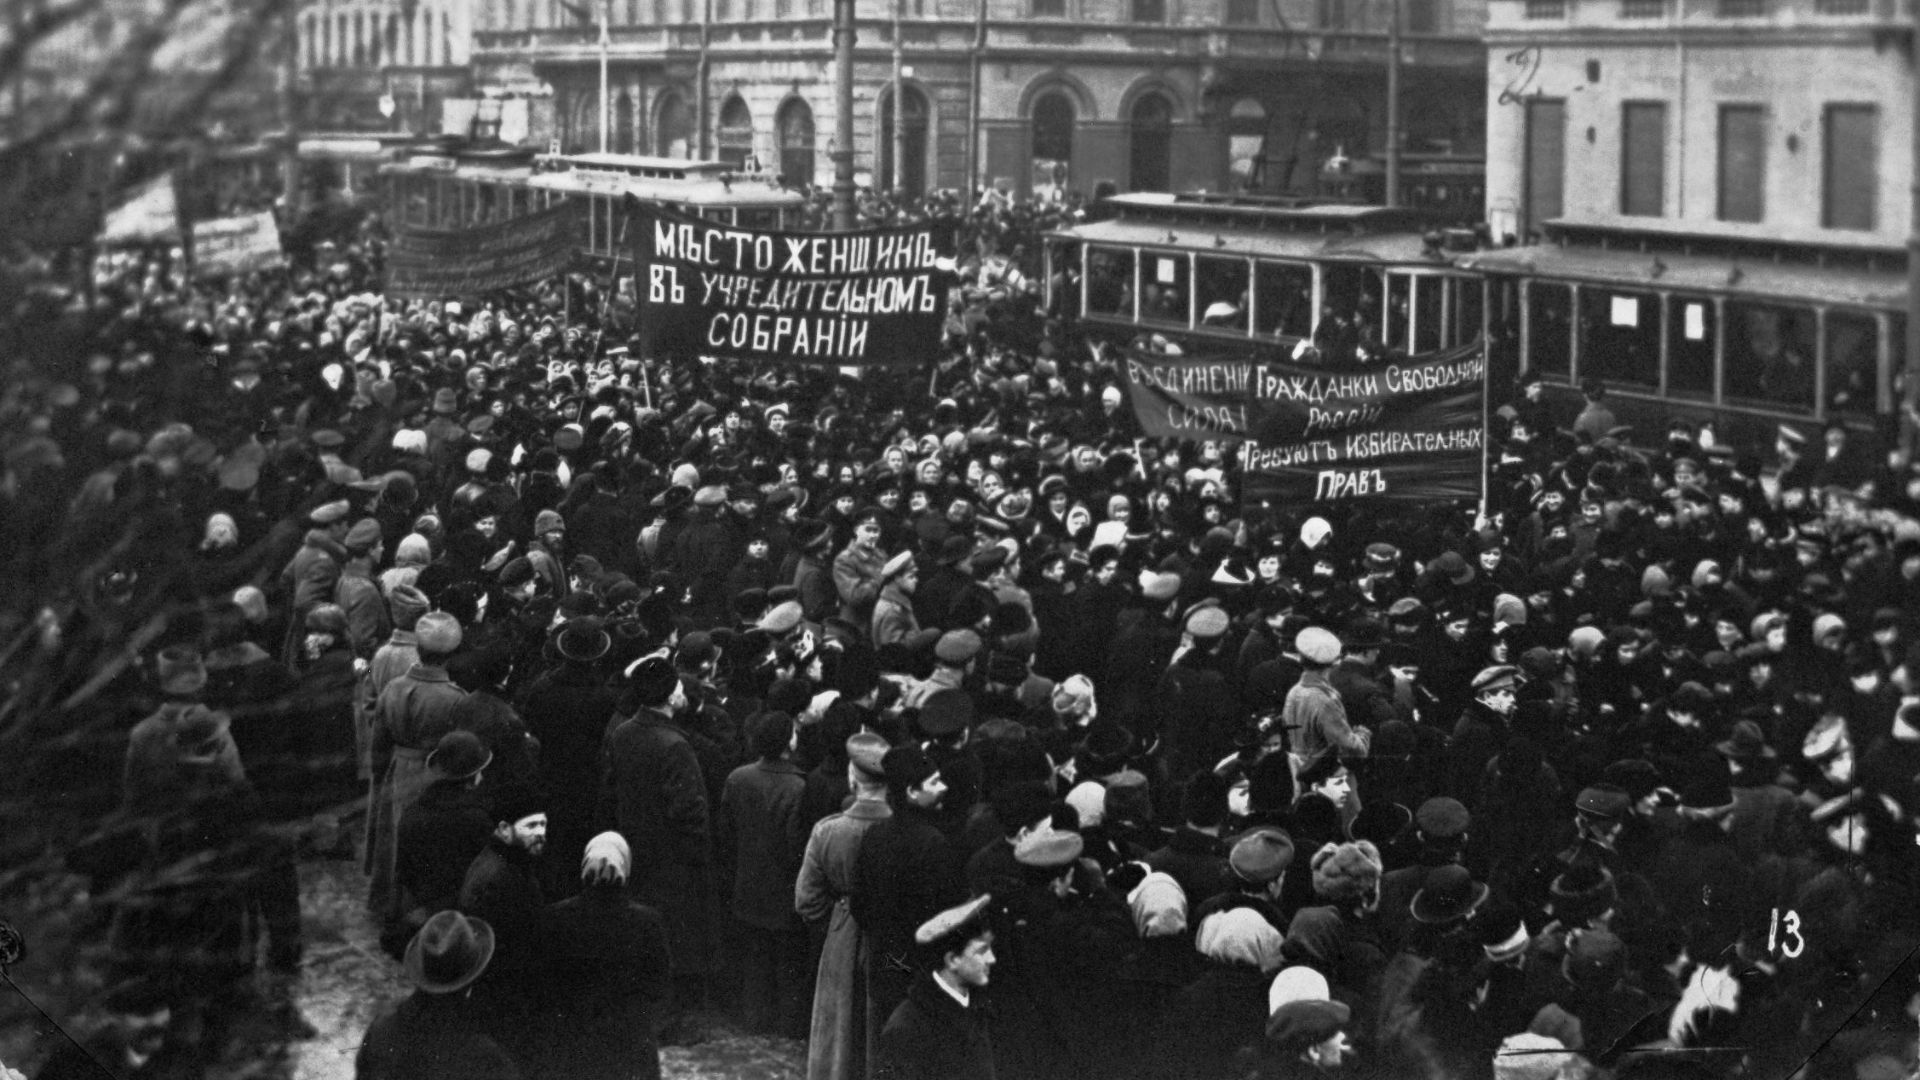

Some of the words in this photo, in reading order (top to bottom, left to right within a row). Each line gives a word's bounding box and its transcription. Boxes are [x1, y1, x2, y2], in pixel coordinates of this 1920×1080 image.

[655, 219, 772, 270] МѢСТО
[783, 232, 936, 274] ЖЕНЩИНѢ
[650, 264, 684, 304] ВЪ
[701, 274, 936, 314] УЧРЕДИТЕЛЬНОМЪ
[708, 312, 868, 355] СОБРАНІИ
